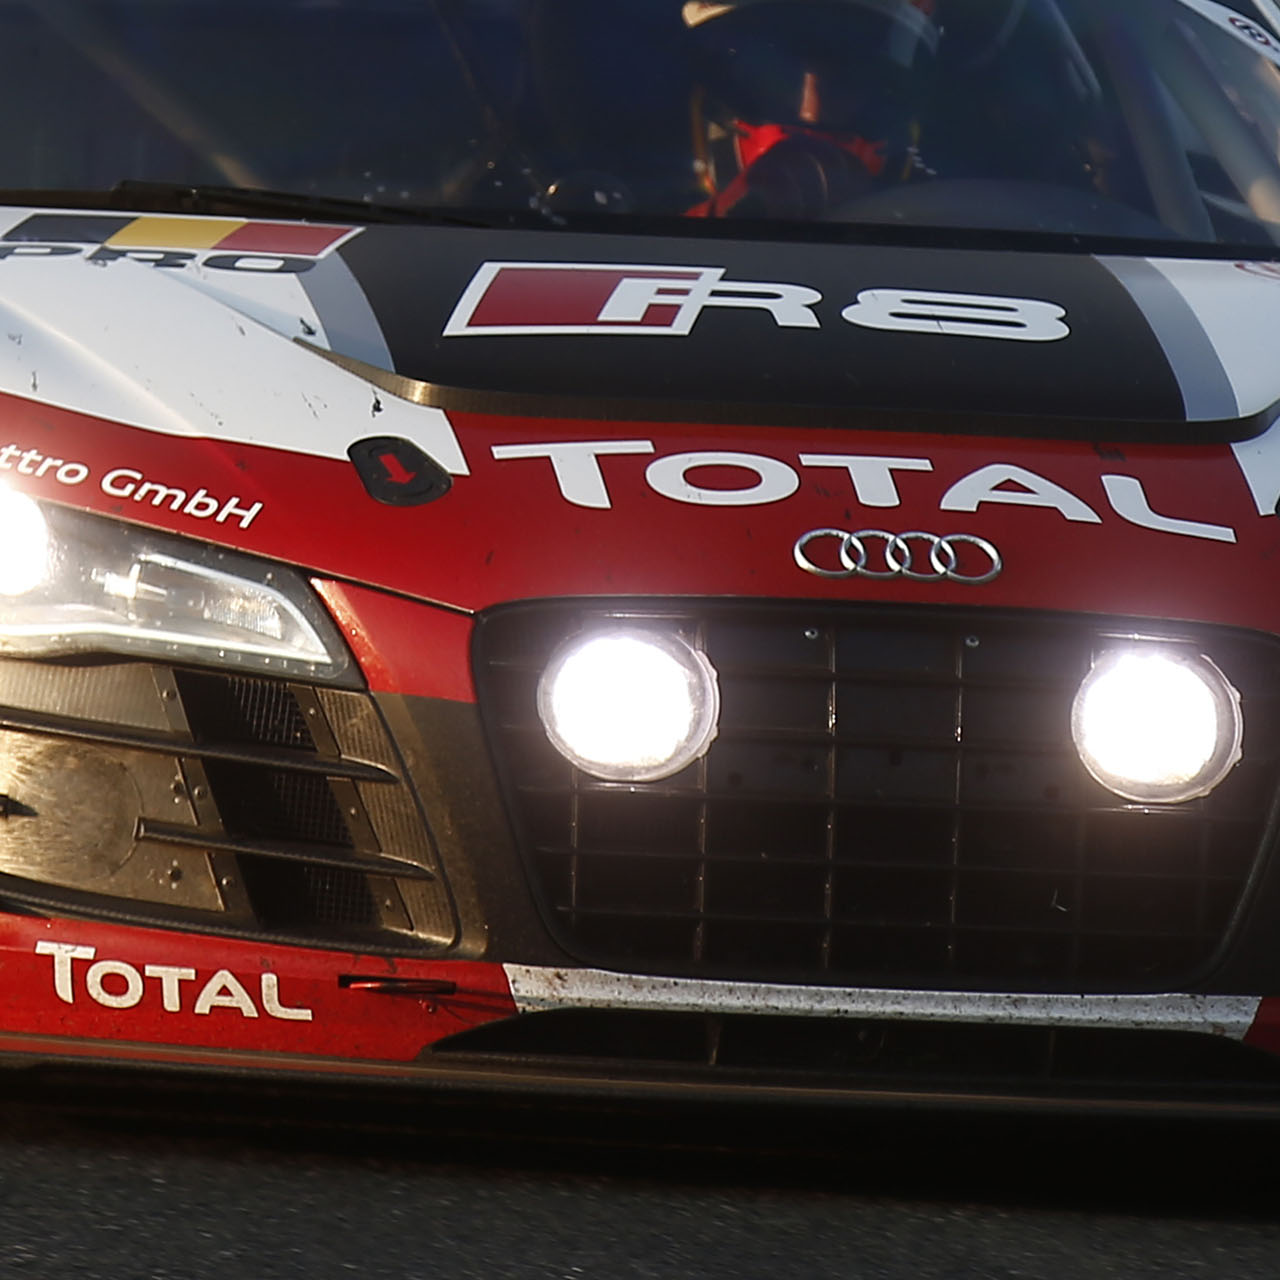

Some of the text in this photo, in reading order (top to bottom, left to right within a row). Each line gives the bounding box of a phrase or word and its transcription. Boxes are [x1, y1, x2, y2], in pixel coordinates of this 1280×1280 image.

[597, 277, 1071, 341] R8
[100, 468, 264, 530] GmbH
[490, 439, 1238, 543] TOTAL
[35, 940, 314, 1022] TOTAL
